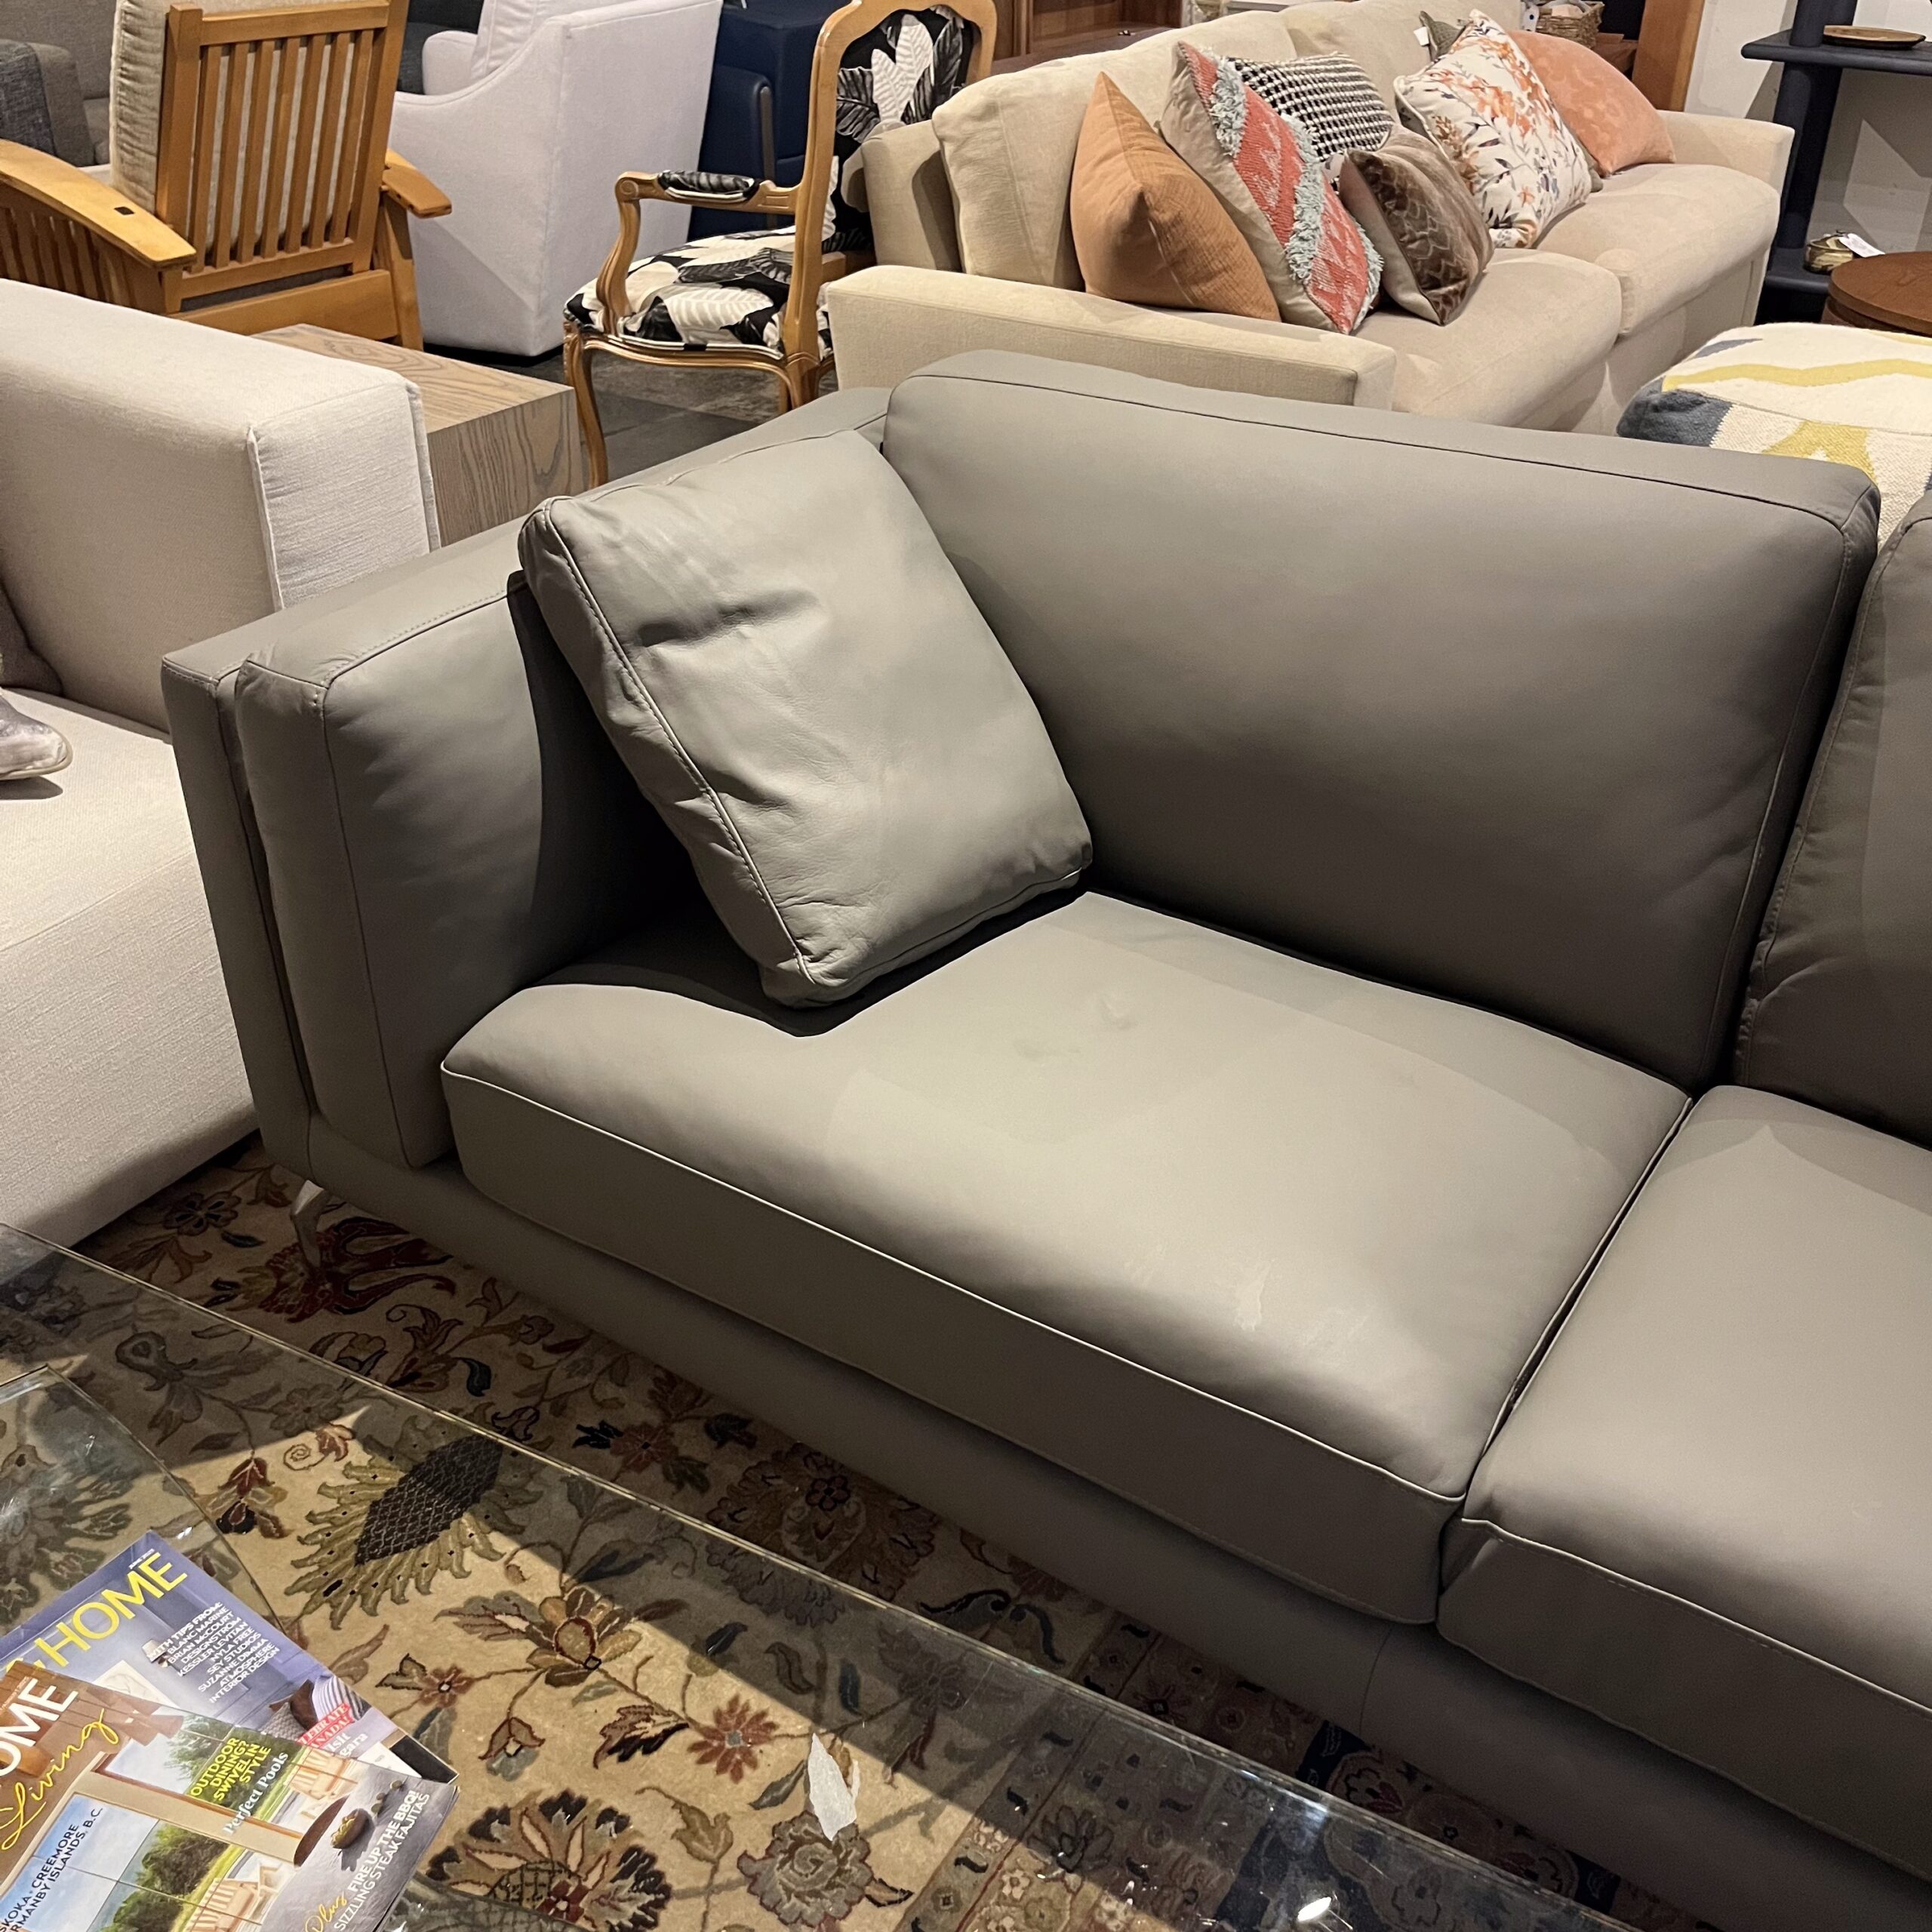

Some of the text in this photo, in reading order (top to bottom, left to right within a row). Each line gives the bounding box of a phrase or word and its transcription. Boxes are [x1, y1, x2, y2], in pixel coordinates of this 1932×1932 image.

[34, 1552, 188, 1667] HOME
[168, 1606, 229, 1654] BLANC MARINE
[168, 1611, 234, 1663] BRIAN McCOURT
[171, 1622, 195, 1640] TIPS
[177, 1622, 249, 1677] KESSLER LEVITAN
[198, 1638, 269, 1692] SUZANNE DIMMA
[207, 1632, 262, 1675] SEY STUDIOS
[211, 1626, 255, 1662] NYLA FREE
[220, 1642, 275, 1687] ATMOSPHERE
[208, 1647, 280, 1703] INTERIOR DESIGN
[0, 1708, 118, 1850] Living
[190, 1737, 240, 1796] OUTDOOR
[210, 1740, 250, 1787] DINING?
[213, 1744, 260, 1801] SWIVEL IN
[239, 1746, 272, 1783] STYLE
[223, 1752, 288, 1834] Perfect Pools
[32, 1824, 79, 1888] CREEMORE
[334, 1793, 430, 1931] SIZZLING STEAK FAJITAS
[347, 1865, 373, 1893] FIRE
[364, 1847, 382, 1865] UP
[377, 1820, 401, 1845] THE
